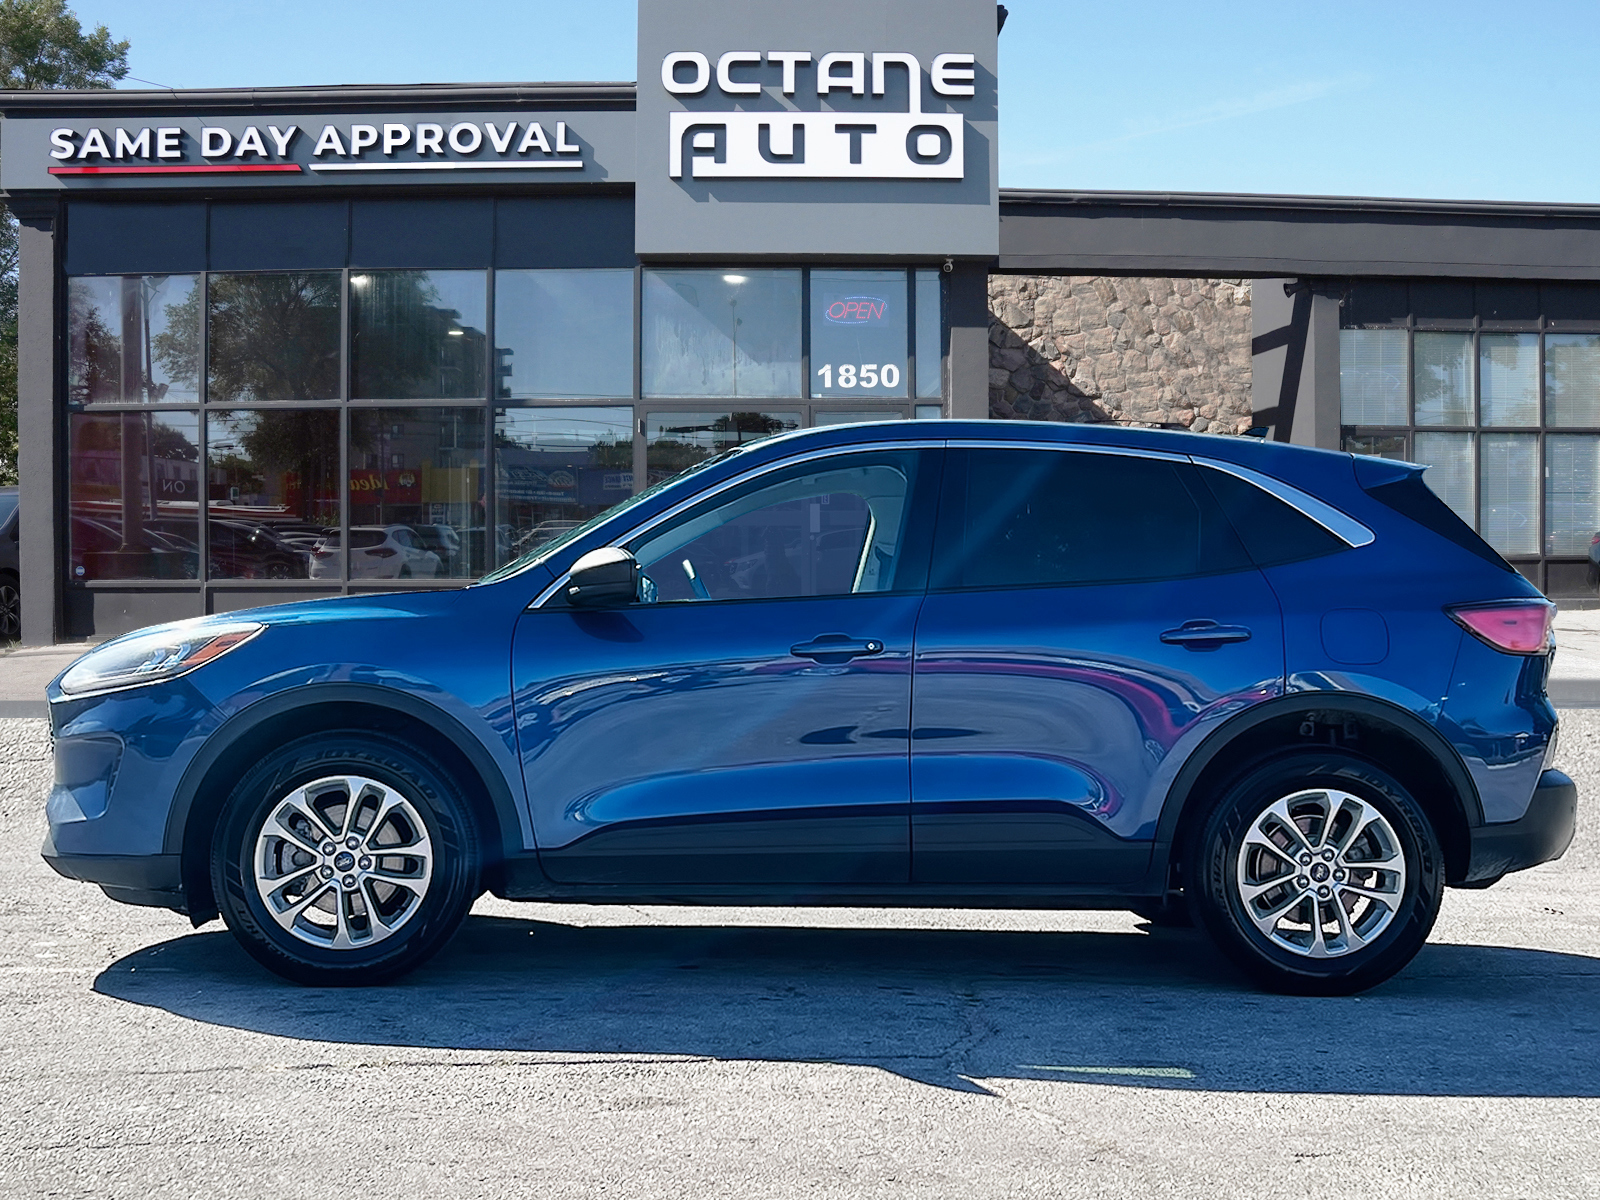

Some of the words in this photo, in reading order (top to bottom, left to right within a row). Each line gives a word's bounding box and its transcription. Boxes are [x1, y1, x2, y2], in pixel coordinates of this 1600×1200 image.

[661, 51, 975, 98] OCTANE
[49, 127, 182, 159] SAME
[201, 125, 299, 158] DAY
[313, 121, 580, 156] APPROVAL
[680, 122, 953, 177] AUTO
[828, 301, 886, 320] OPEN
[817, 363, 900, 389] 1850
